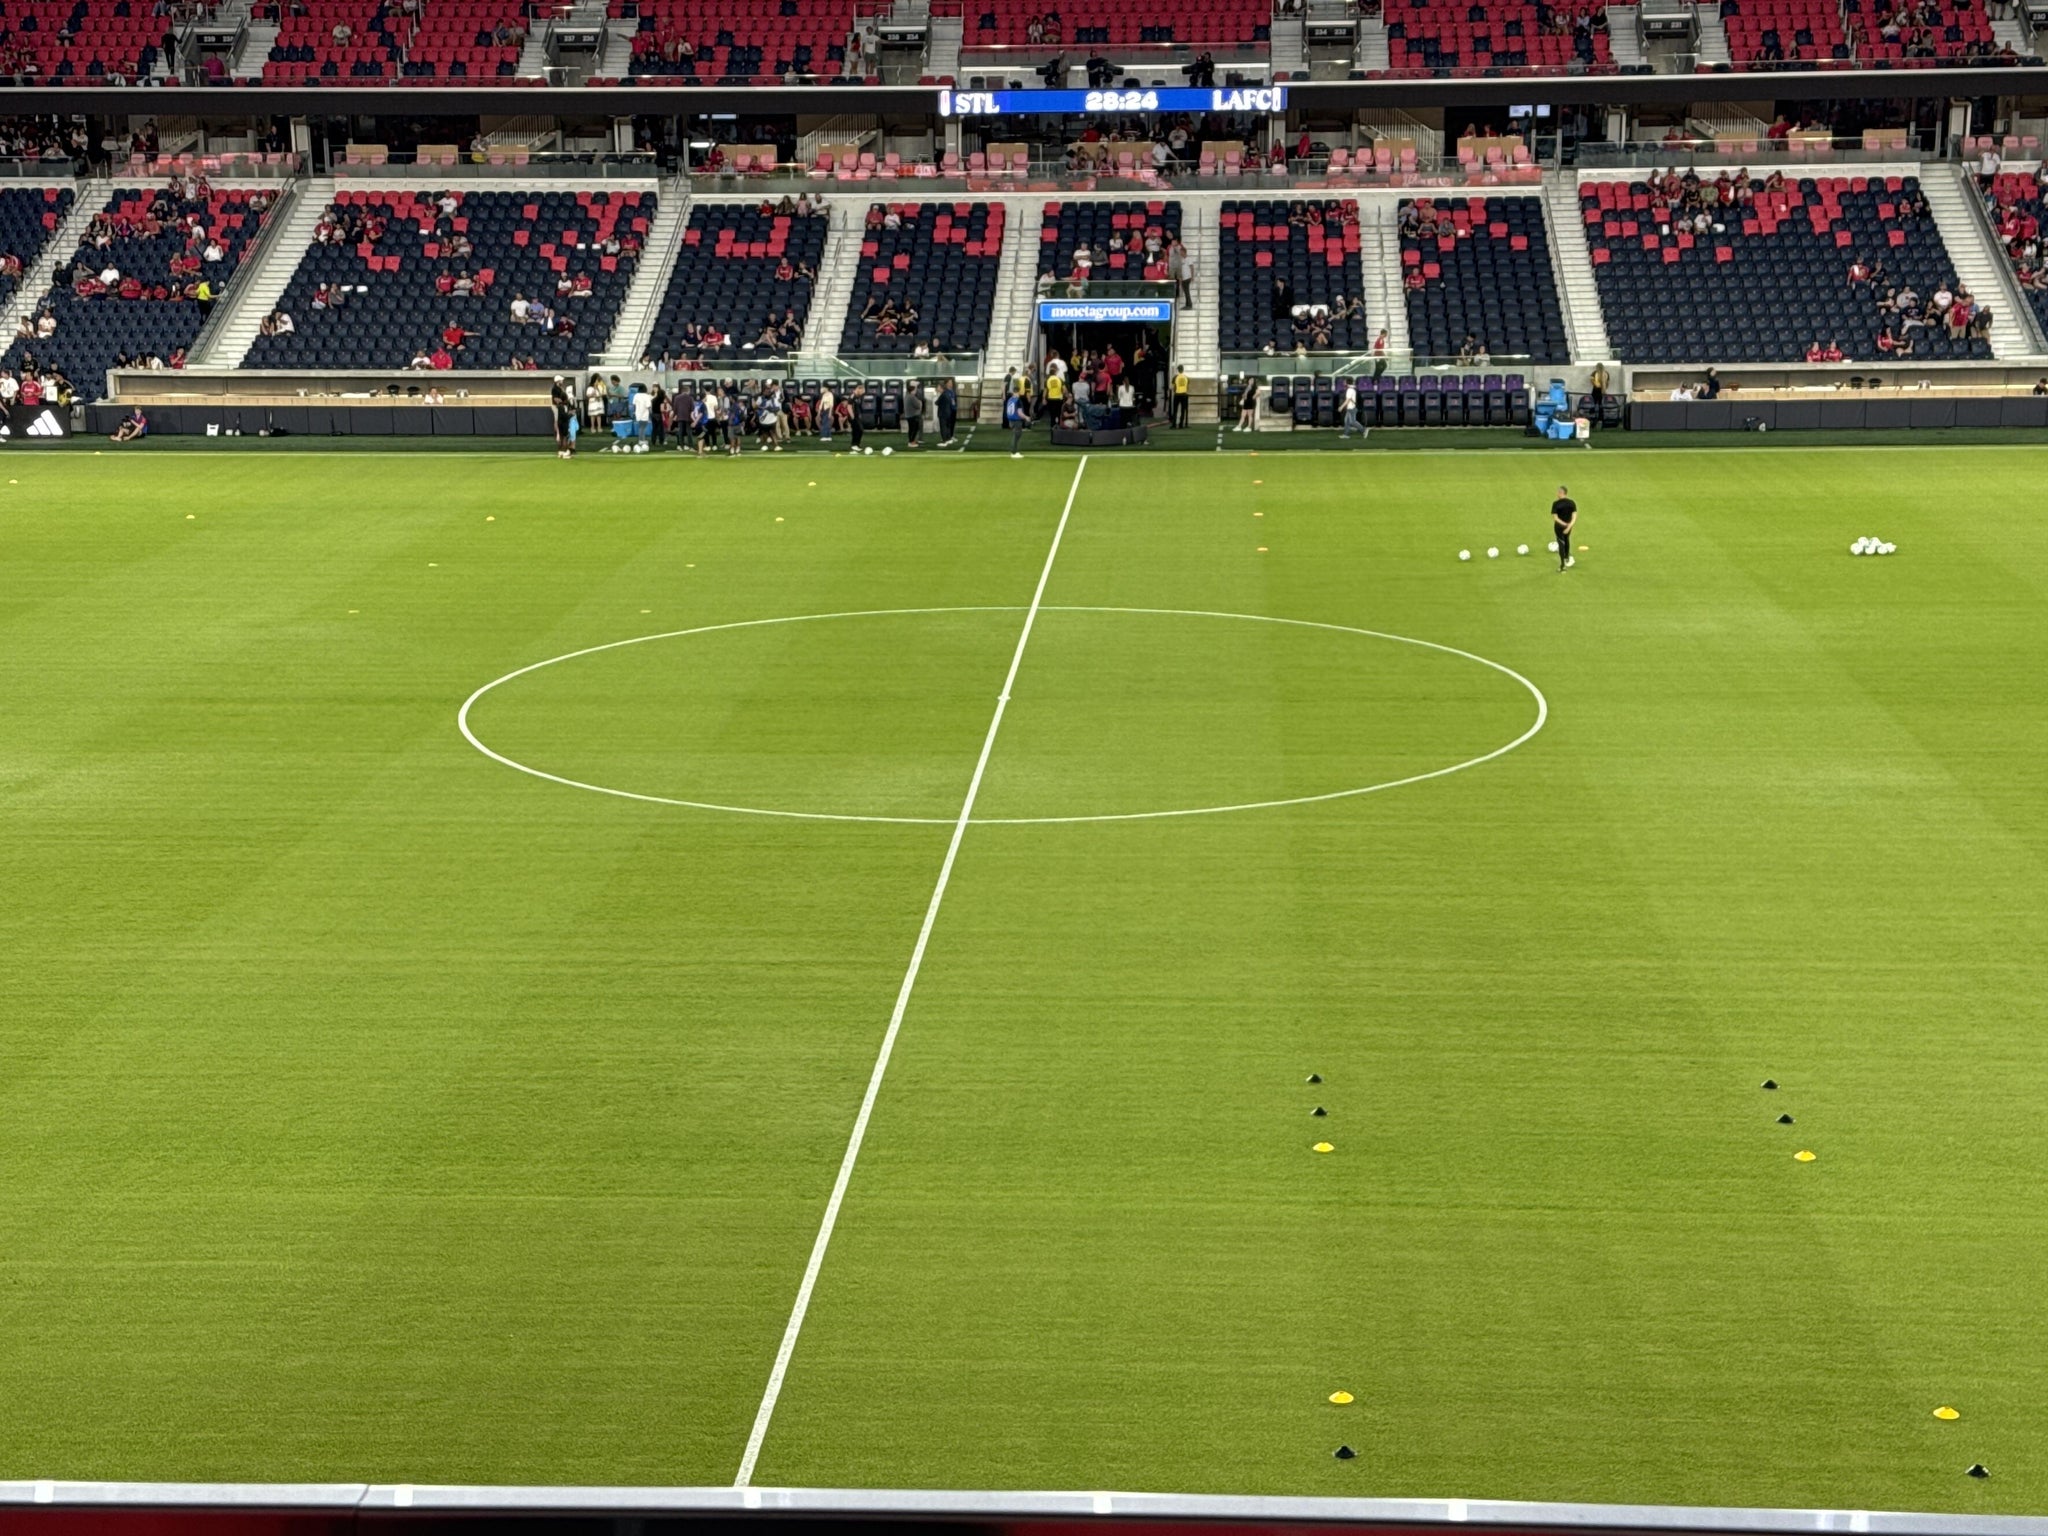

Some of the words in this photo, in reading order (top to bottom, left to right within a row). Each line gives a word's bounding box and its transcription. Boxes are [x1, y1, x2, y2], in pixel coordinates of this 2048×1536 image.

[955, 93, 1000, 113] STL
[1085, 91, 1158, 111] 28:24
[1212, 90, 1272, 110] LAFC
[1051, 306, 1159, 320] monetagroup.com
